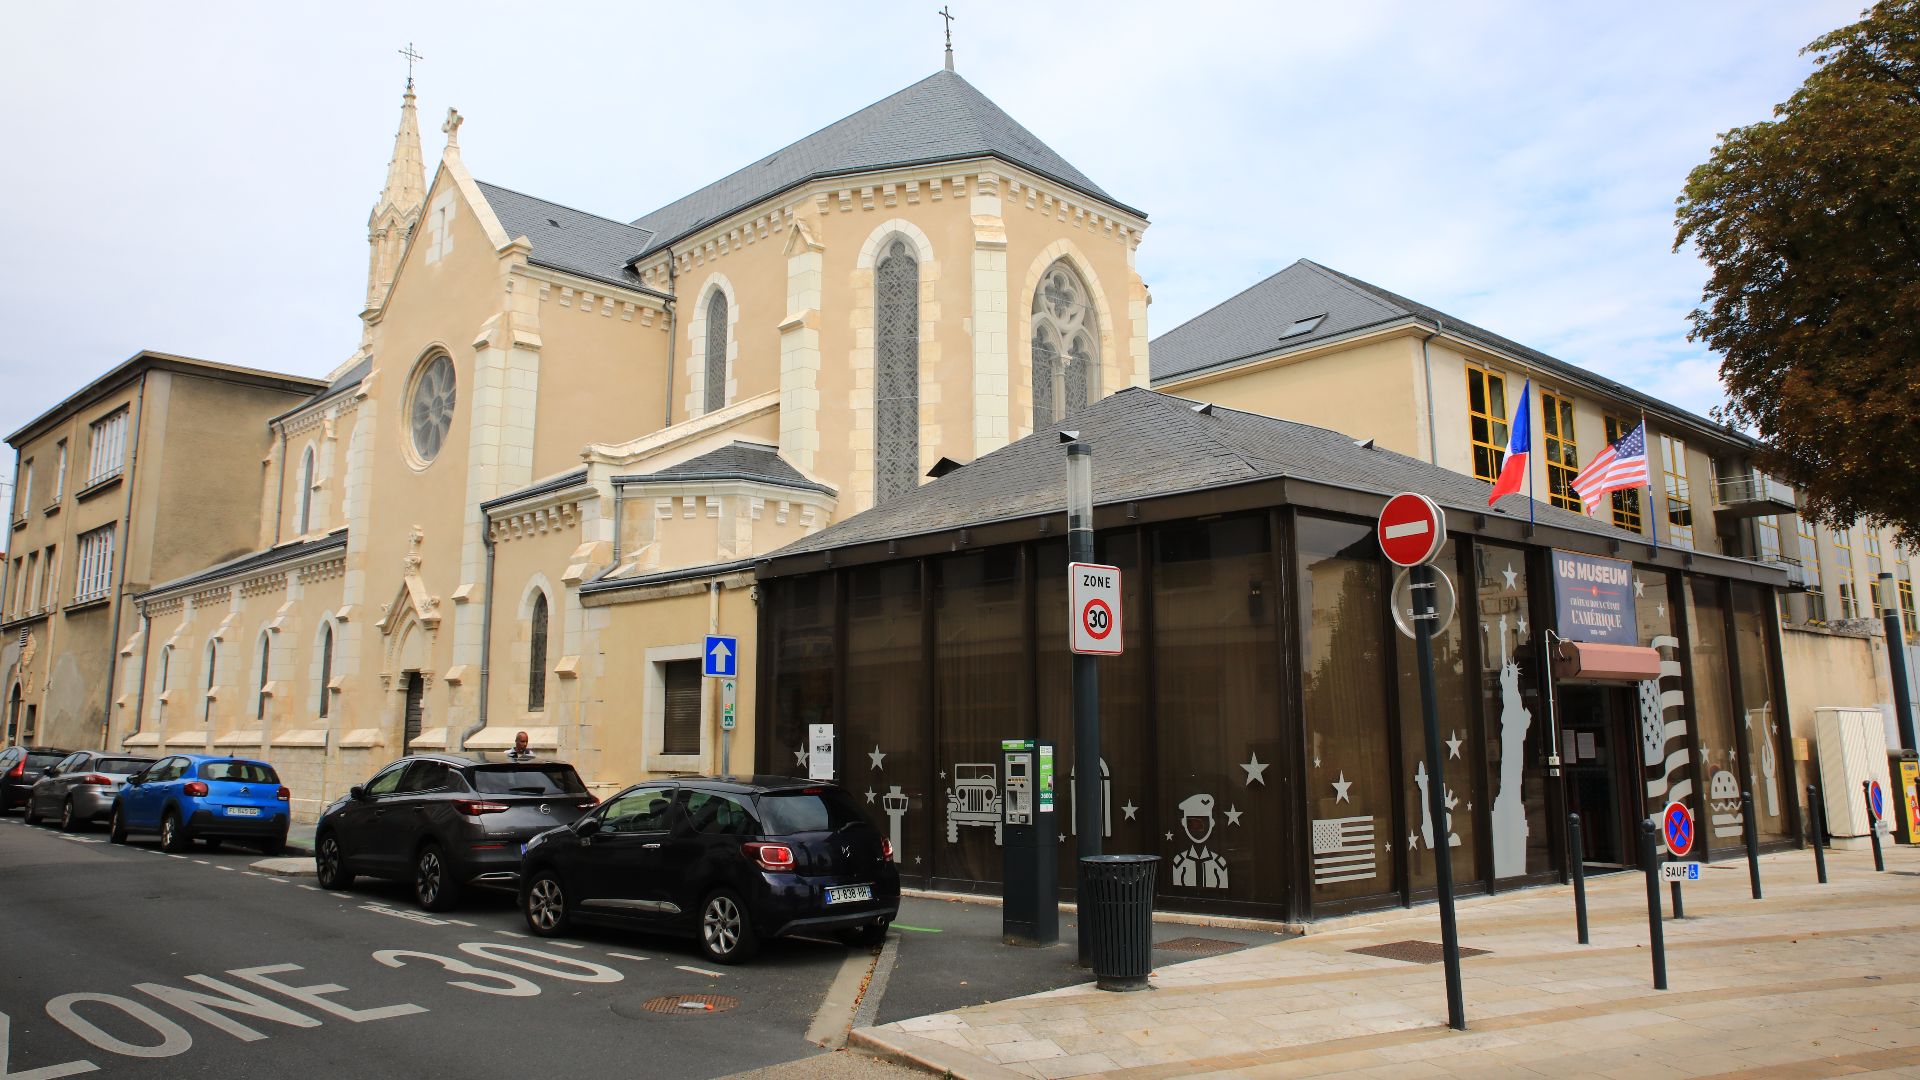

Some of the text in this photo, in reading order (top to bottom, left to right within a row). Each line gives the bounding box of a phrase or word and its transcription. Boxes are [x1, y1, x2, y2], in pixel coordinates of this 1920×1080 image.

[1083, 574, 1111, 588] ZONE
[1559, 559, 1628, 586] US MUSEUM
[1089, 609, 1108, 629] 30
[1571, 609, 1622, 631] L'AMÉRIQUE
[1665, 866, 1687, 877] SAUF
[371, 941, 626, 998] 30
